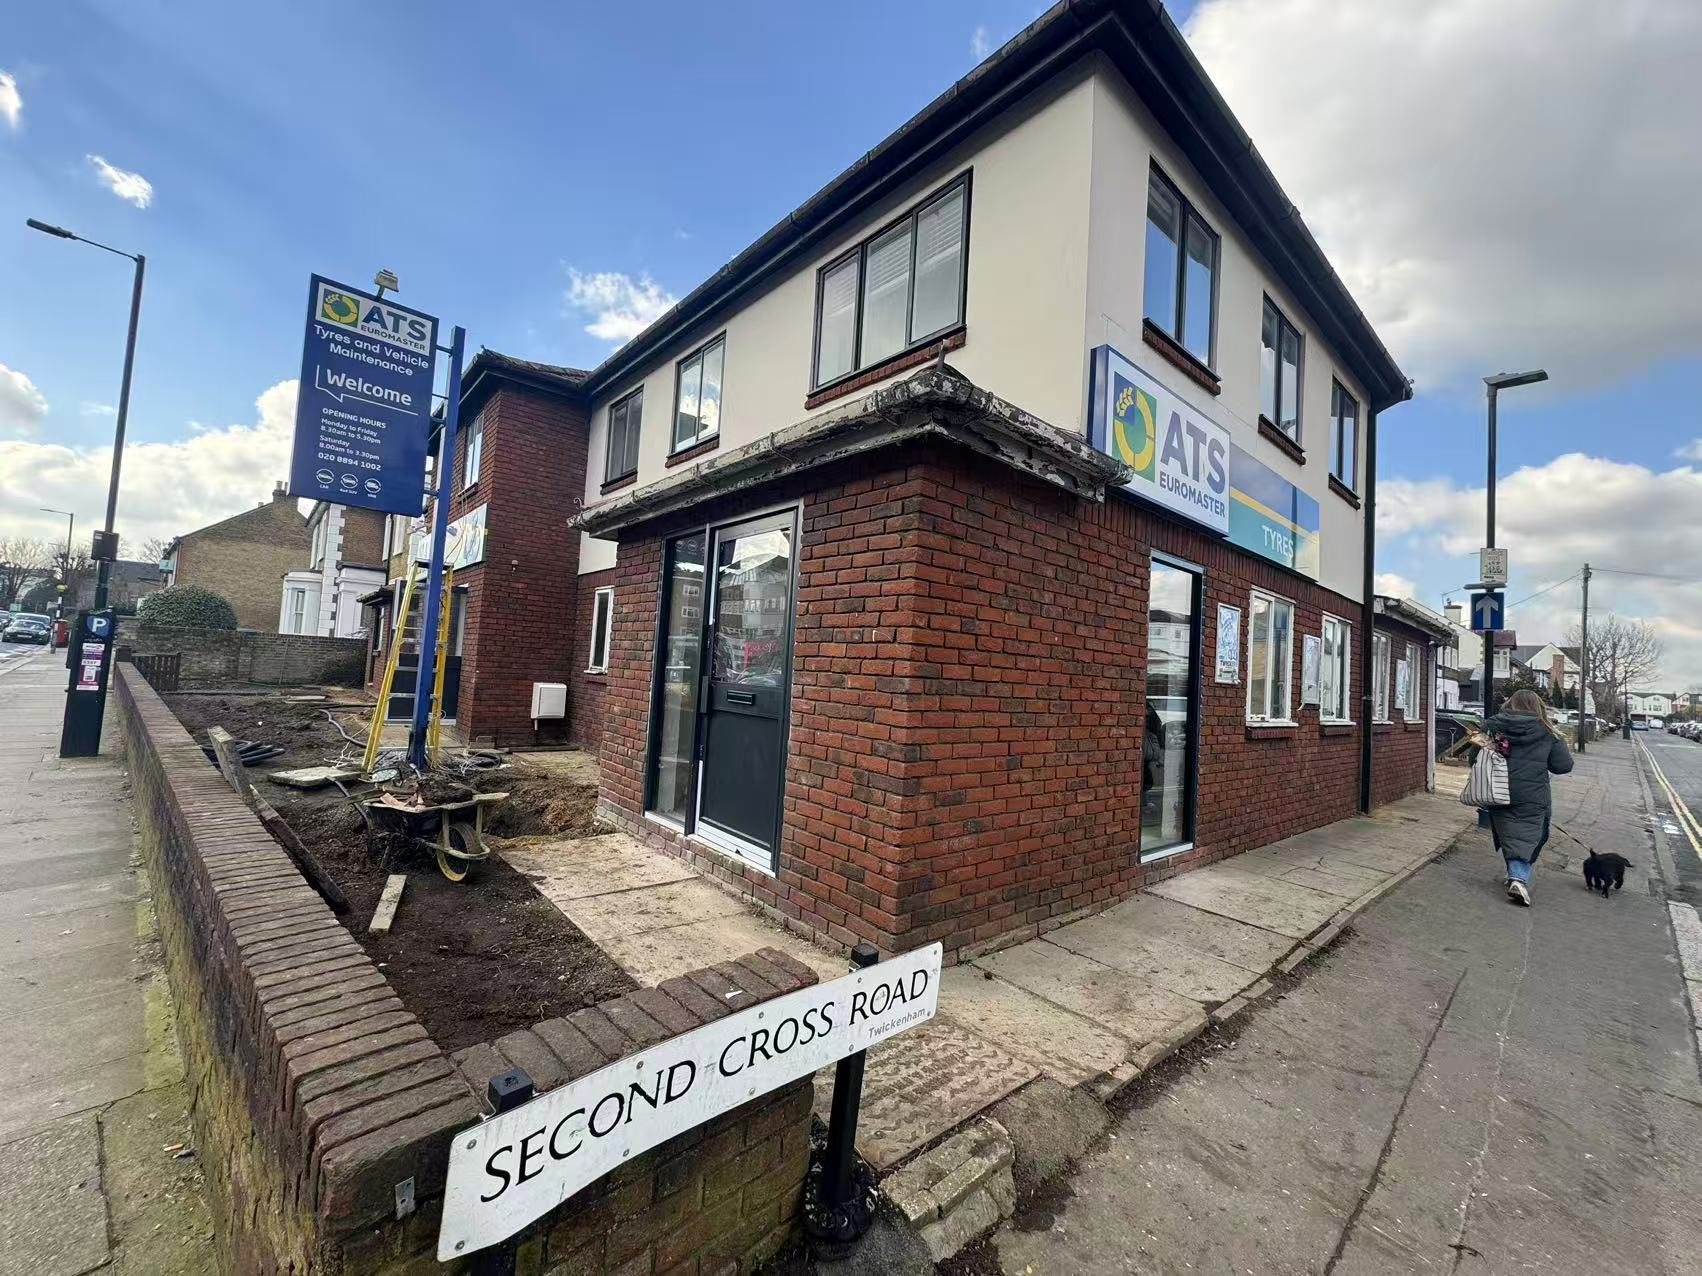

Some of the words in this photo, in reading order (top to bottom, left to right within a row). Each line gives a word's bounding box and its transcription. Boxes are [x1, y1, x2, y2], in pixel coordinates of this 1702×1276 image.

[360, 325, 426, 352] EUROMASTER
[362, 305, 427, 342] ATS
[314, 324, 351, 344] Tyres
[354, 339, 380, 354] and
[384, 346, 429, 369] Vehicle
[329, 342, 413, 376] Maintenance
[326, 368, 412, 406] Welcome
[320, 425, 347, 436] 8.30am
[321, 418, 348, 430] Monday
[357, 426, 378, 437] Friday
[322, 407, 358, 422] OPENING
[359, 417, 386, 429] HOURS
[319, 434, 350, 448] Saturday
[1160, 410, 1226, 495] ATS
[318, 452, 335, 461] 020
[336, 455, 359, 467] 8894
[360, 460, 382, 471] 1002
[1159, 470, 1226, 519] EUROMASTER
[1261, 524, 1294, 558] TYRES
[92, 618, 107, 633] P
[868, 1008, 926, 1039] Twickenham
[481, 1060, 696, 1204] SECOND
[718, 1001, 835, 1077] CROSS
[848, 968, 929, 1026] ROAD
